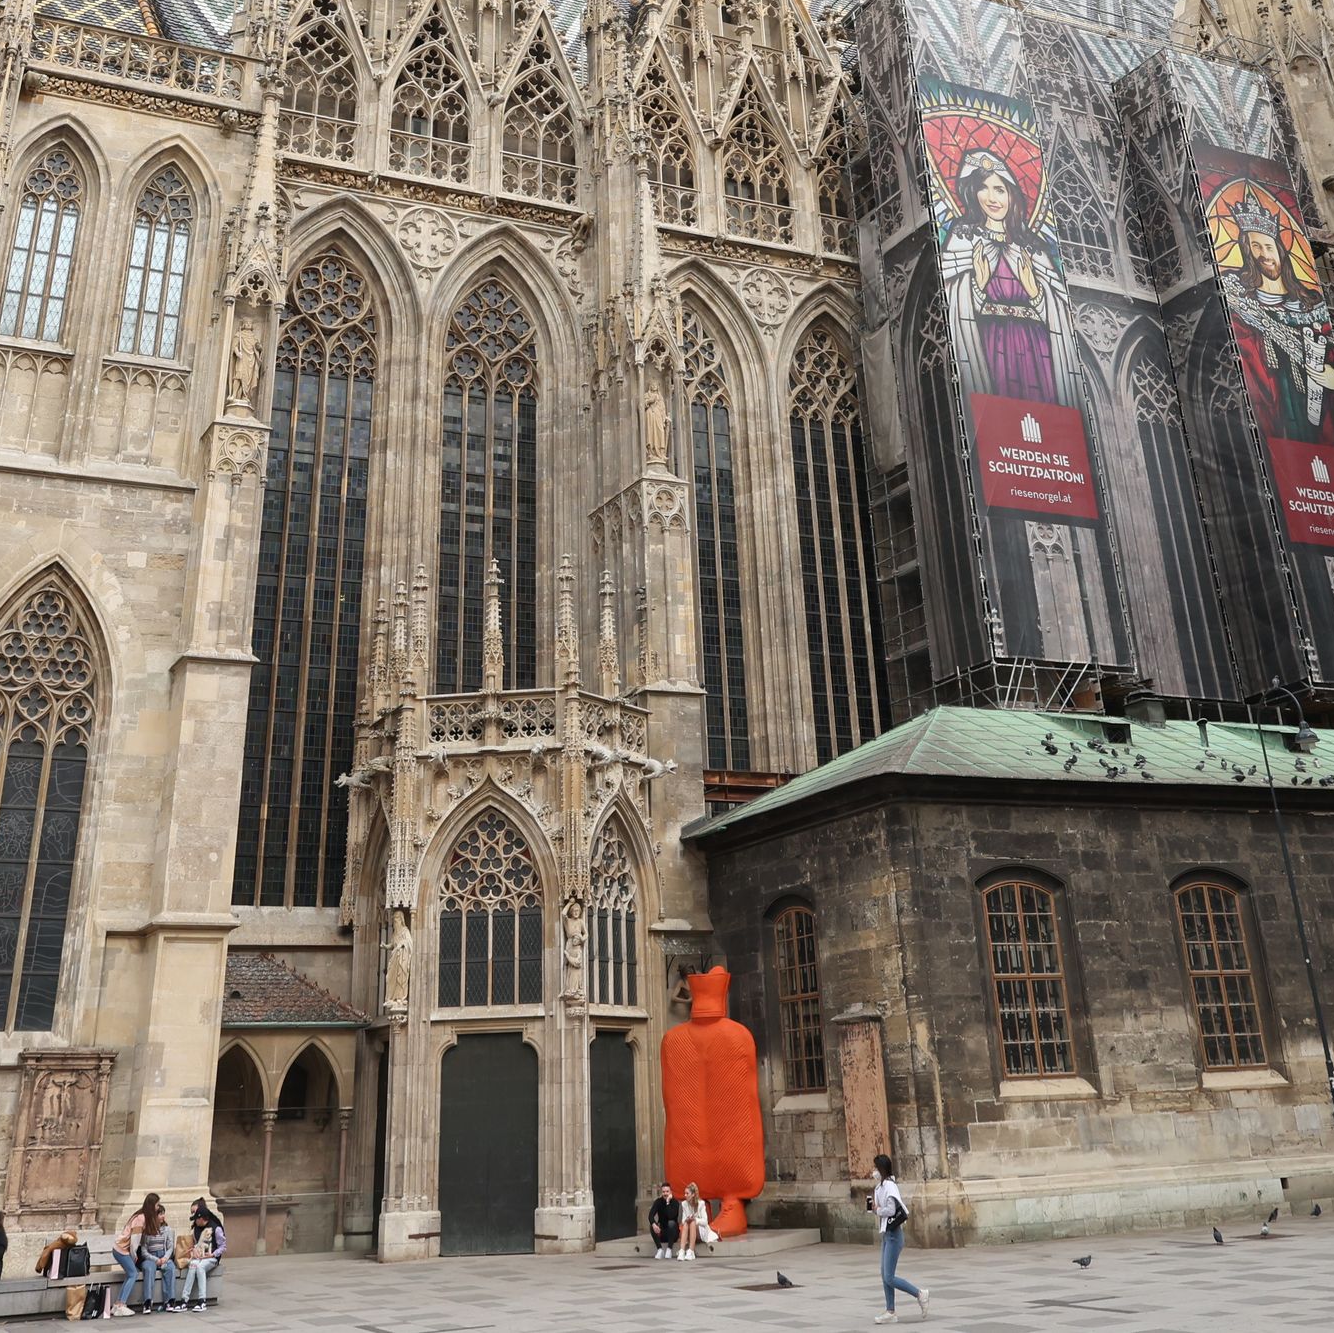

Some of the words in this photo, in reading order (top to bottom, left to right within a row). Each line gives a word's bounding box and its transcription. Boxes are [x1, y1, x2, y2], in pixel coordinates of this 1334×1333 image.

[999, 446, 1051, 464] WERDEN
[1053, 454, 1070, 467] SIE
[989, 461, 1085, 484] SCHUTZPATRON!
[1011, 487, 1071, 504] riesenorgel.at
